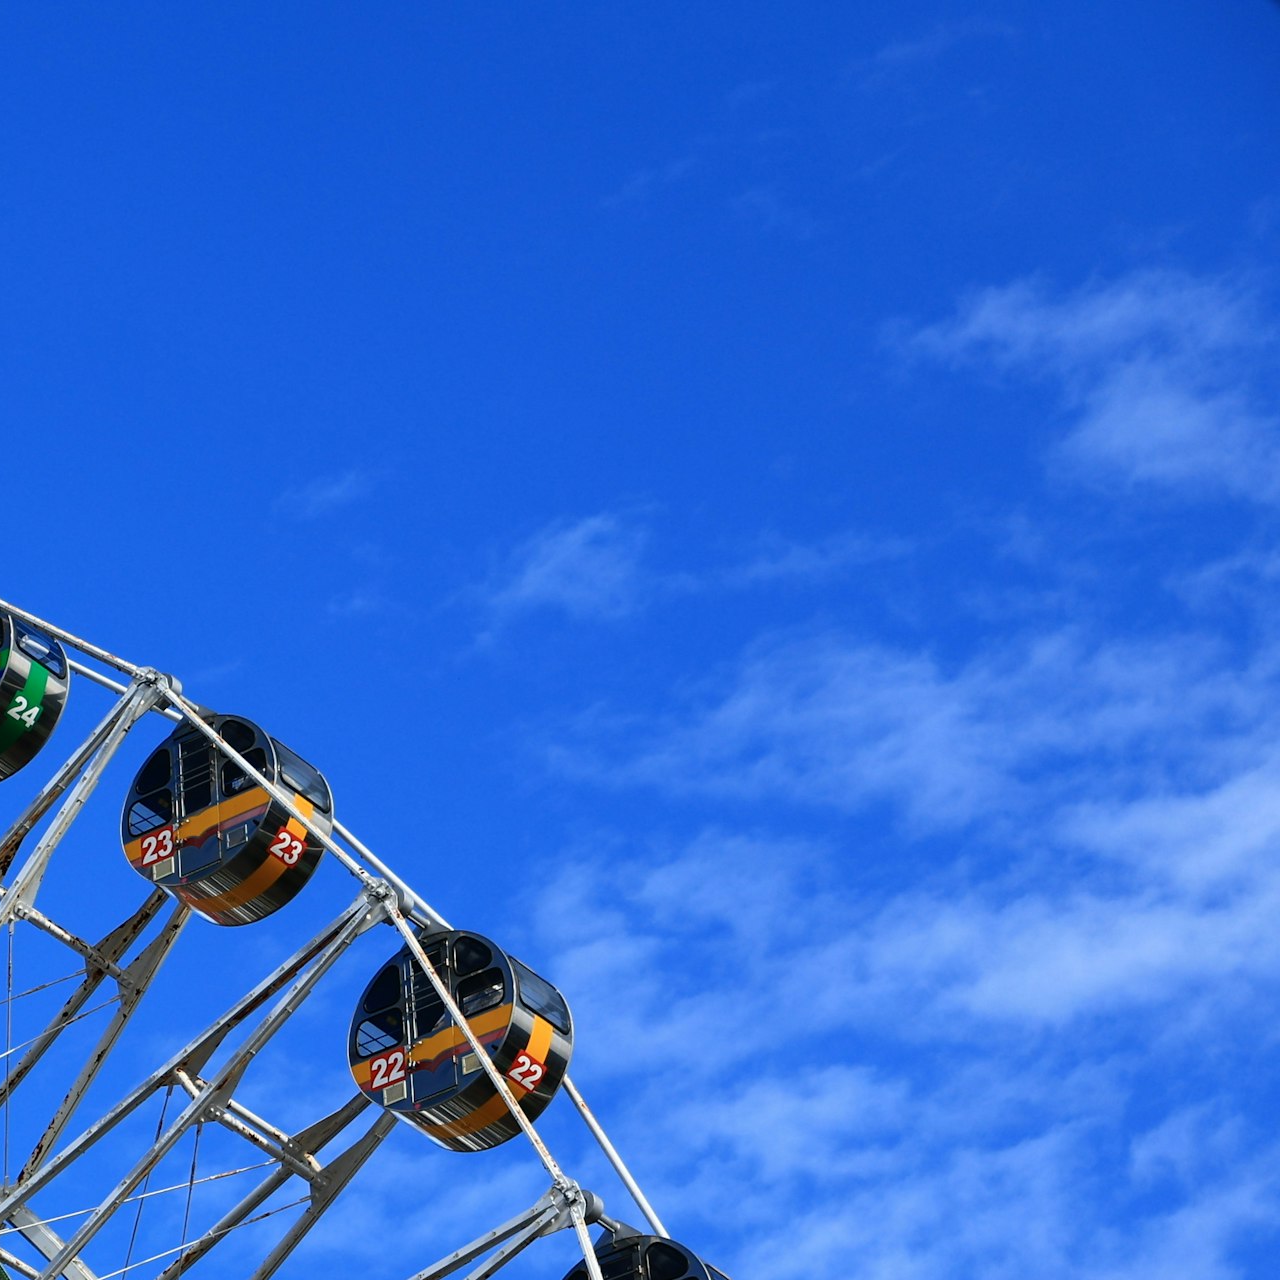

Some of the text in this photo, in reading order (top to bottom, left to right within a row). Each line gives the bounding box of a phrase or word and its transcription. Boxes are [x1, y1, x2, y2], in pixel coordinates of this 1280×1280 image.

[8, 696, 39, 728] 24
[142, 830, 173, 864] 23
[271, 831, 303, 864] 23
[371, 1052, 405, 1089] 22
[509, 1055, 543, 1090] 22
